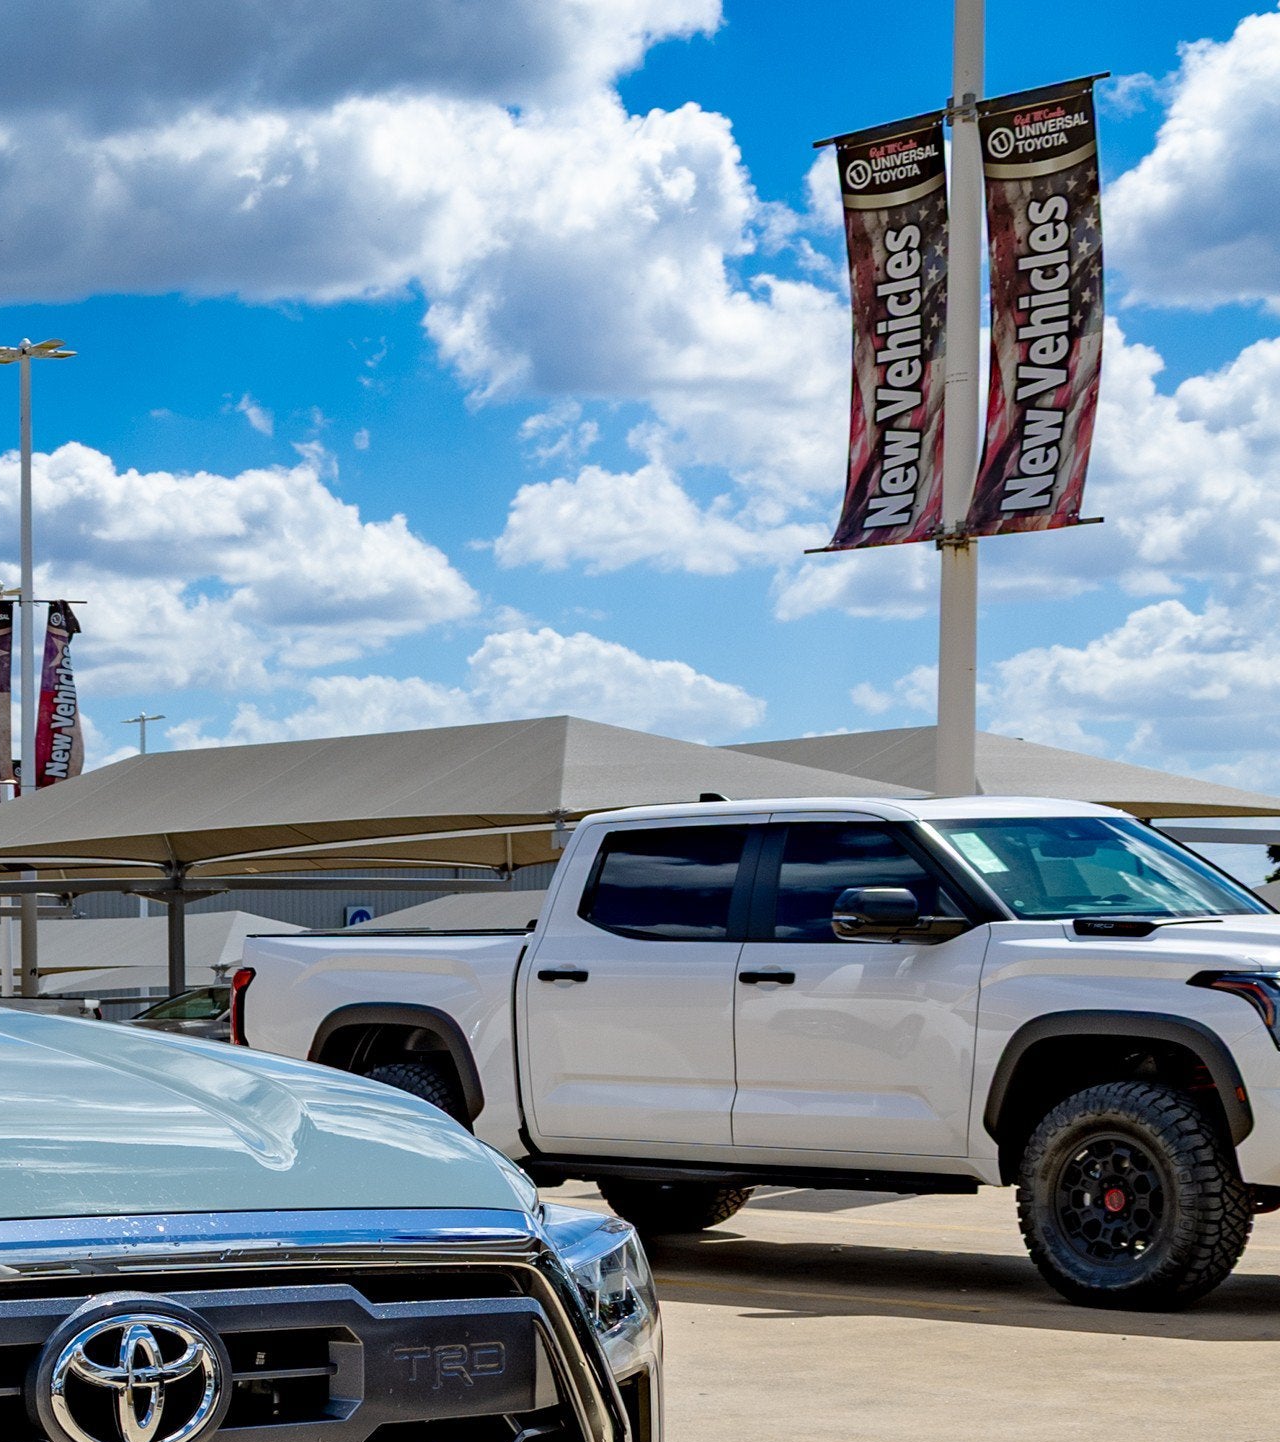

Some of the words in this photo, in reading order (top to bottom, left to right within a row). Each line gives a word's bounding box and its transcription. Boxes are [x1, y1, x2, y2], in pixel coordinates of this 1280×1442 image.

[1015, 112, 1089, 139] UNIVERSAL
[1015, 131, 1069, 154] TOYOTA
[871, 144, 939, 171] UNIVERSAL
[872, 163, 921, 185] TOYOTA
[1016, 195, 1070, 400] Vehicles
[876, 223, 922, 423] Vehicles
[863, 431, 920, 530] New
[1000, 409, 1065, 511] New
[45, 734, 73, 778] New
[393, 1341, 506, 1390] TRD
